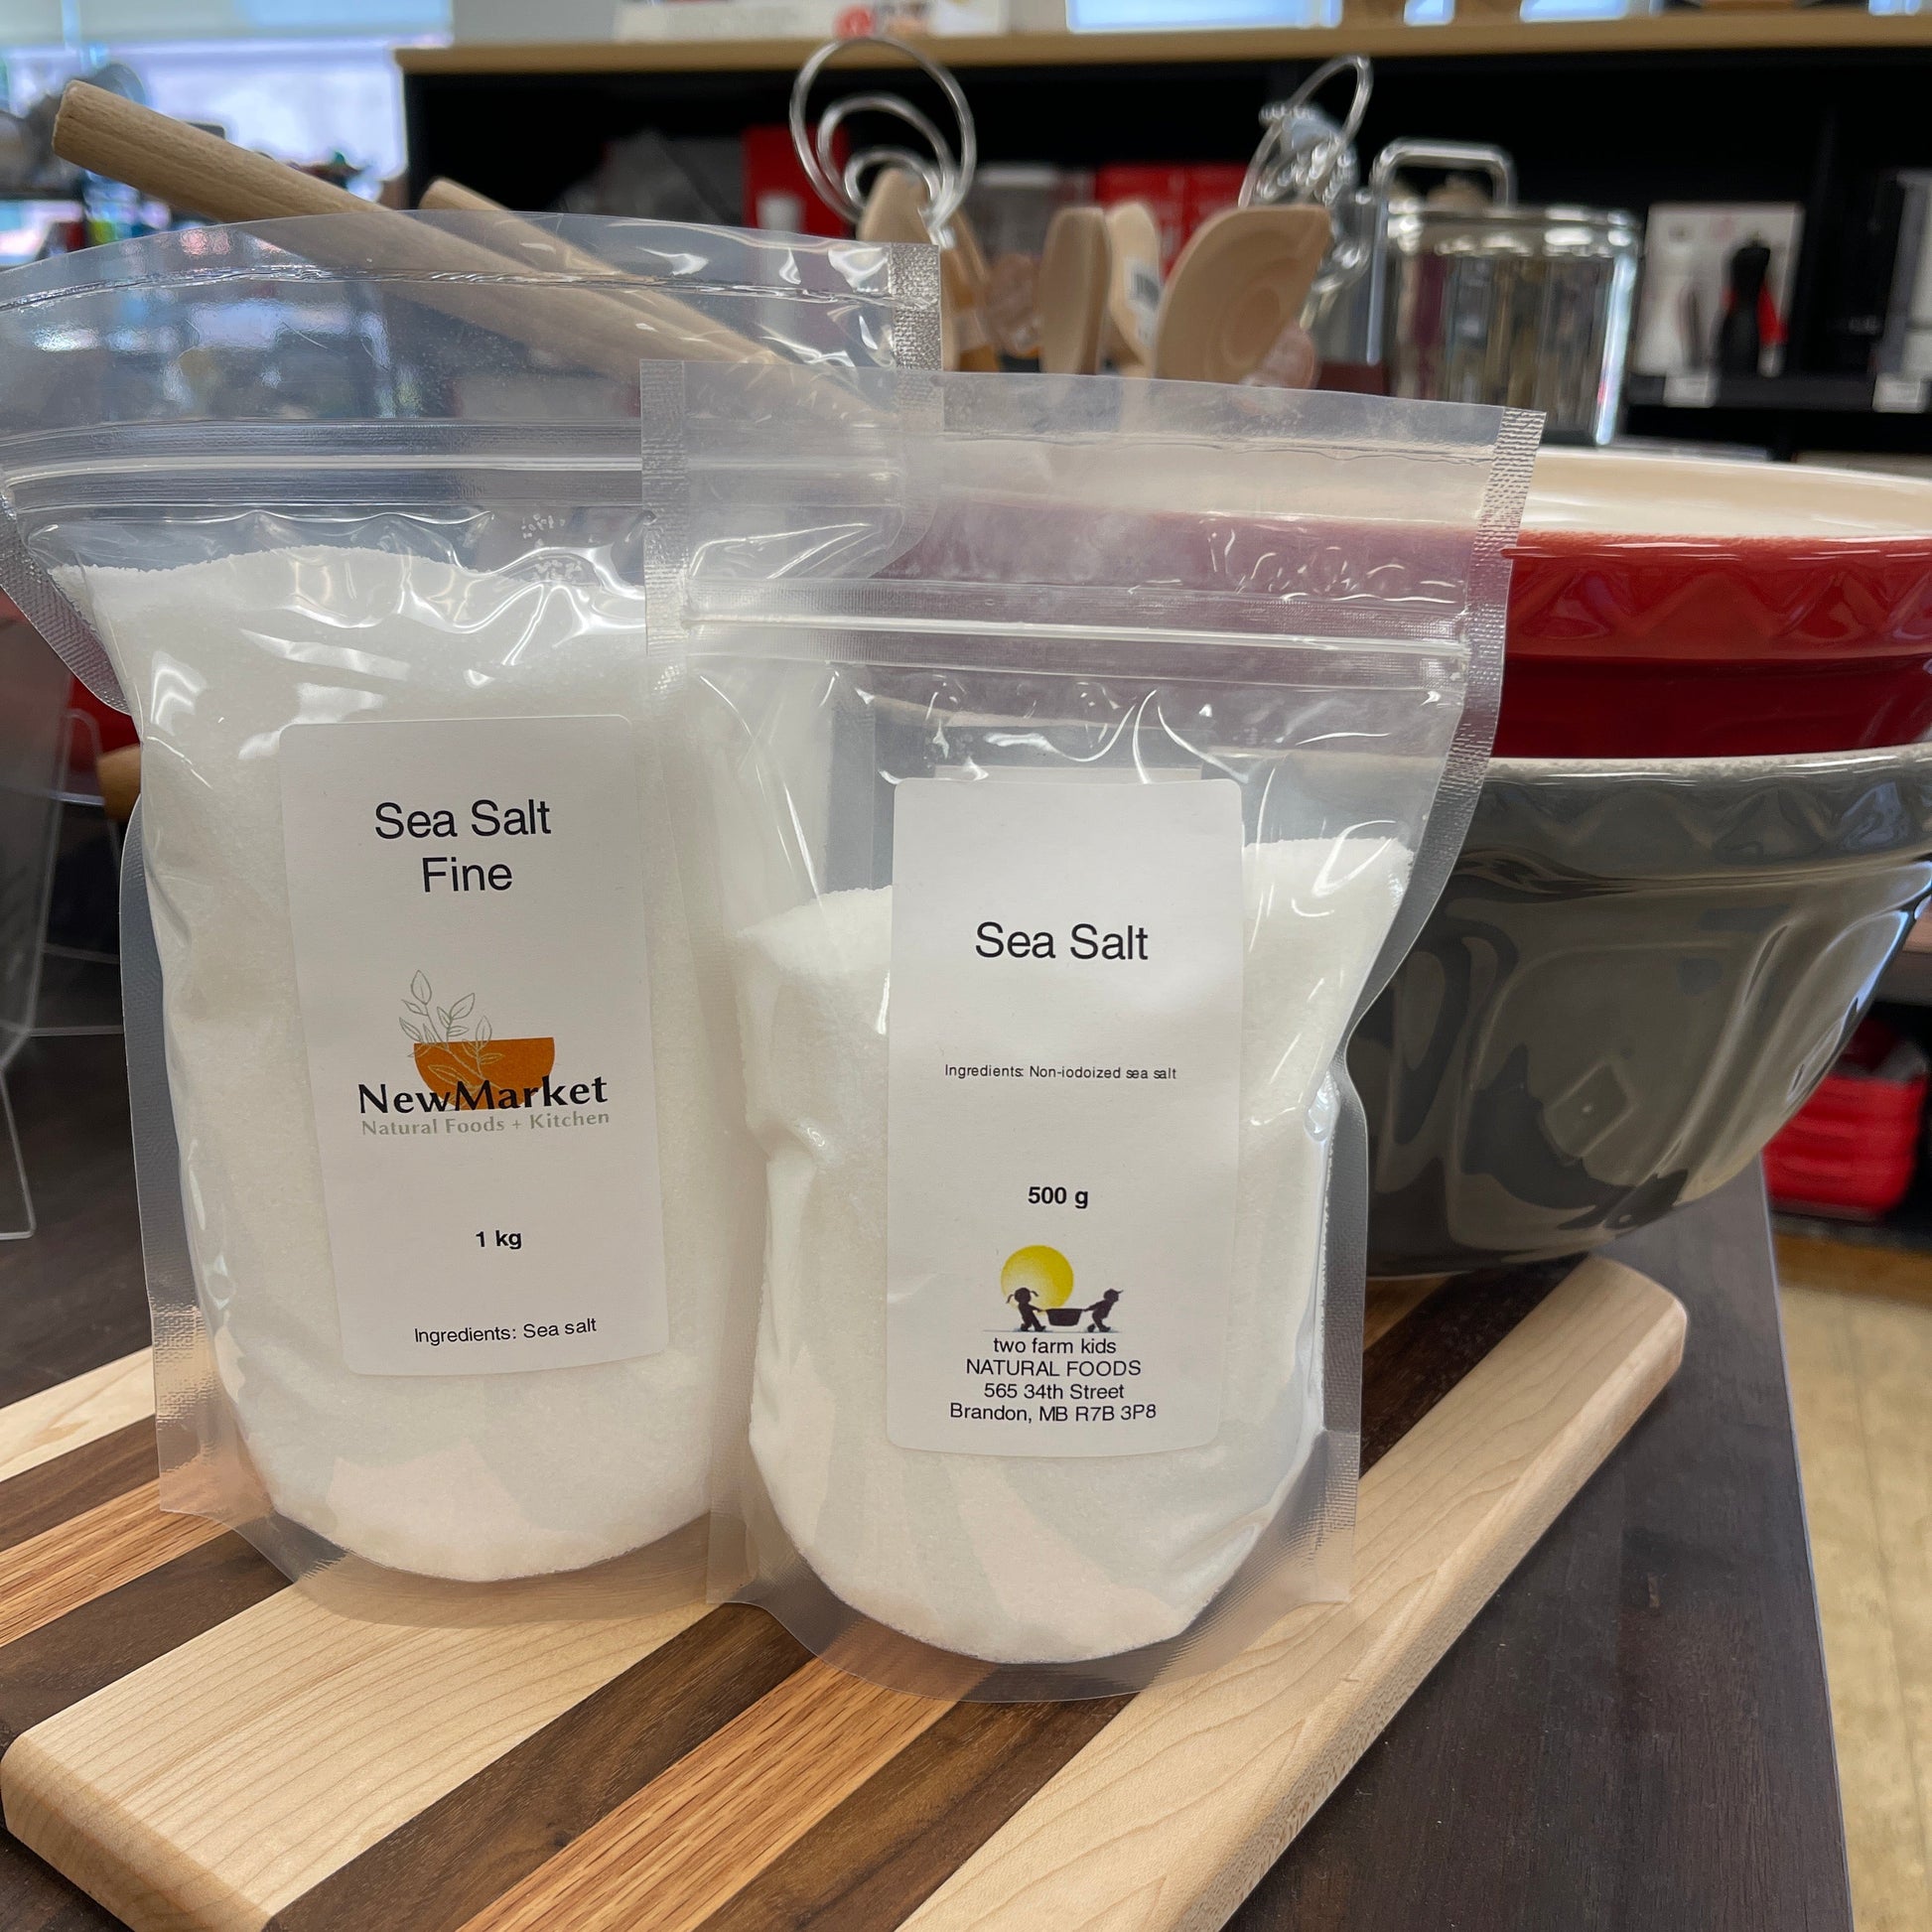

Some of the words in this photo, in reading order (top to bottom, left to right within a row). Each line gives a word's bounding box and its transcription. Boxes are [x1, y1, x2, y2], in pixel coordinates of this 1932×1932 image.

[375, 802, 458, 839] Sea
[471, 799, 552, 837] Salt
[422, 857, 512, 893] Fine
[975, 921, 1056, 959] Sea
[1070, 923, 1149, 960] Salt
[945, 1064, 1024, 1079] Ingredients:
[1030, 1065, 1121, 1078] Non-iodoized
[1126, 1069, 1149, 1079] sea
[1154, 1067, 1177, 1079] salt
[358, 1074, 609, 1114] NewMarket
[361, 1118, 438, 1136] Natural
[445, 1116, 504, 1134] Foods
[529, 1110, 610, 1130] Kitchen
[1028, 1186, 1067, 1204] 500
[1075, 1190, 1089, 1209] g
[476, 1231, 485, 1247] 1
[495, 1230, 522, 1250] kg
[414, 1325, 517, 1346] Ingredients:
[523, 1323, 560, 1338] Sea
[564, 1318, 597, 1335] salt
[993, 1337, 1027, 1353] two
[1033, 1337, 1073, 1354] farm
[1081, 1338, 1117, 1354] kids
[966, 1358, 1060, 1377] NATURAL
[1067, 1360, 1142, 1377] FOODS
[984, 1383, 1018, 1399] 565
[1024, 1383, 1063, 1400] 34th
[1070, 1384, 1125, 1400] Street
[950, 1403, 1033, 1424] Brandon,
[1039, 1406, 1068, 1422] MB
[1075, 1406, 1115, 1422] R7B
[1121, 1404, 1157, 1421] 3P8
